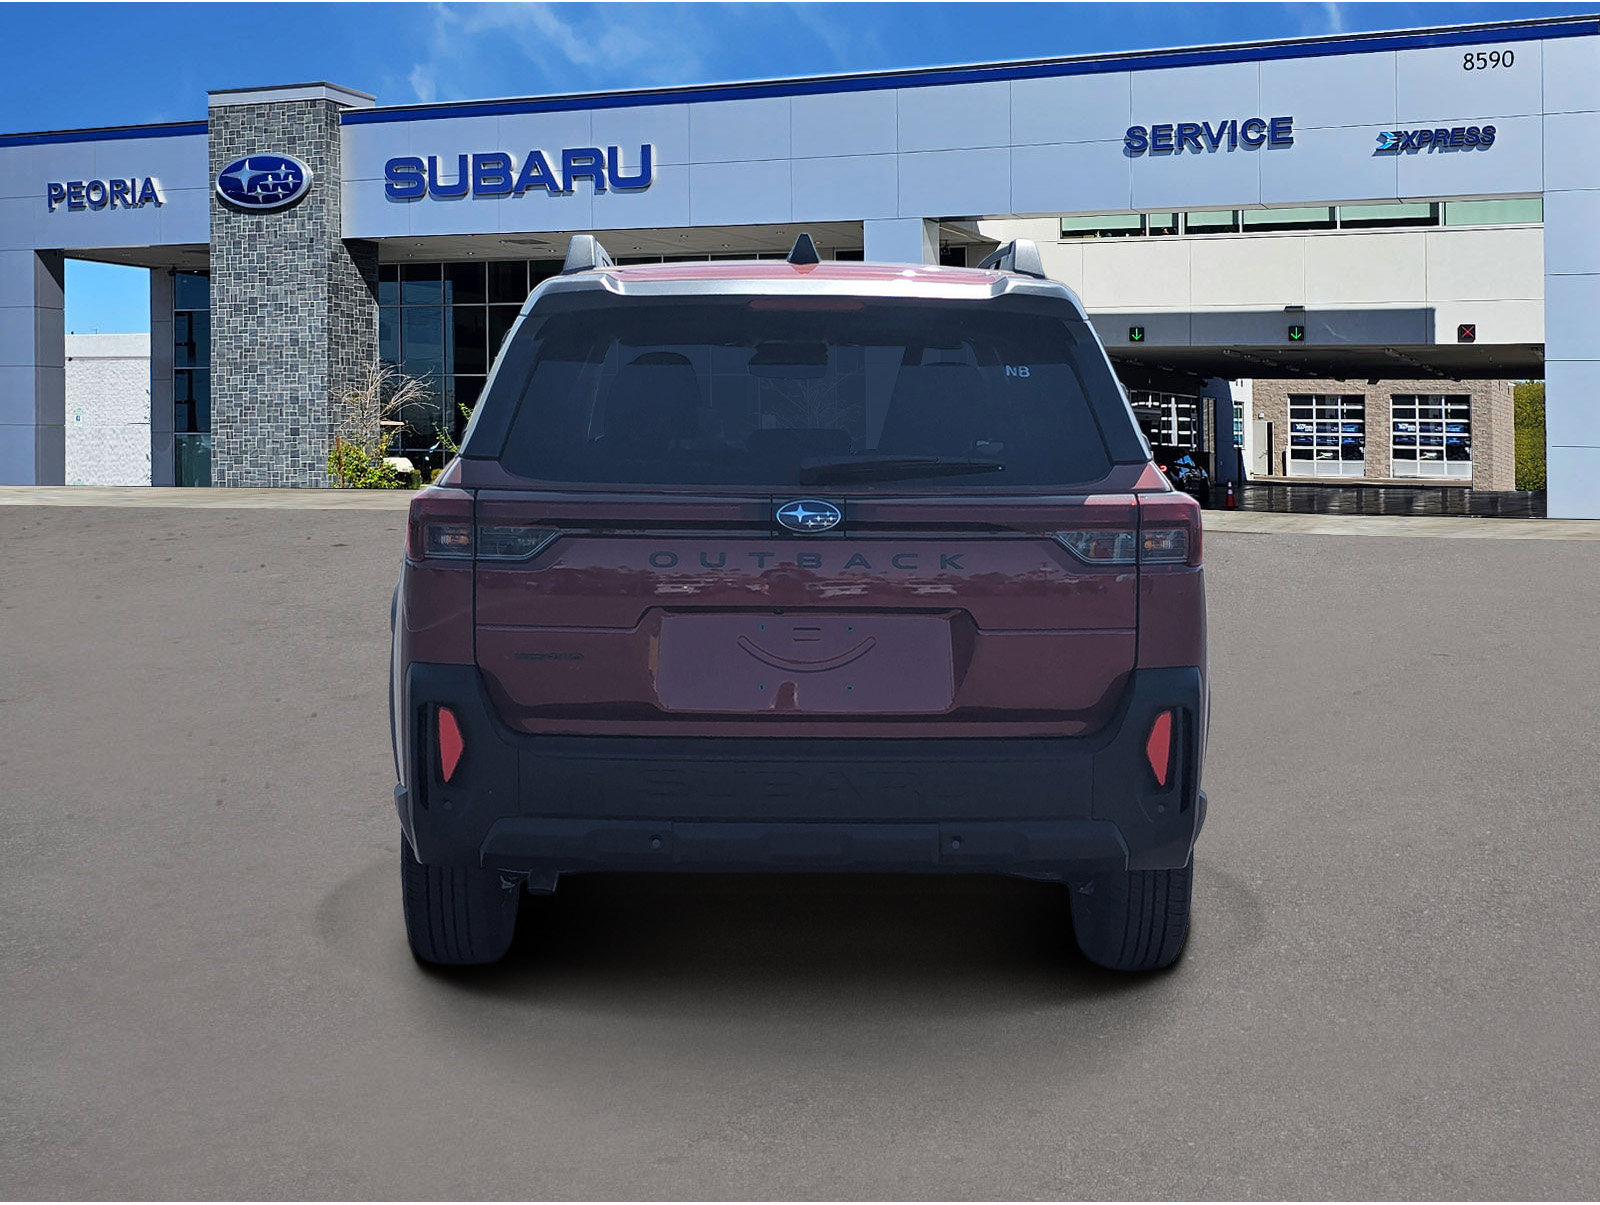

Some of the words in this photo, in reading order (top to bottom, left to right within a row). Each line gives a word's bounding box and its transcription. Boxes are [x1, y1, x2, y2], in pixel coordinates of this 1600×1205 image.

[1463, 50, 1515, 71] 8590
[1125, 116, 1294, 153] SERVICE
[1376, 125, 1496, 151] EXPRESS
[385, 144, 652, 200] SUBARU
[47, 176, 163, 212] PEORIA
[1004, 364, 1031, 378] NB
[649, 551, 965, 571] OUTBACK
